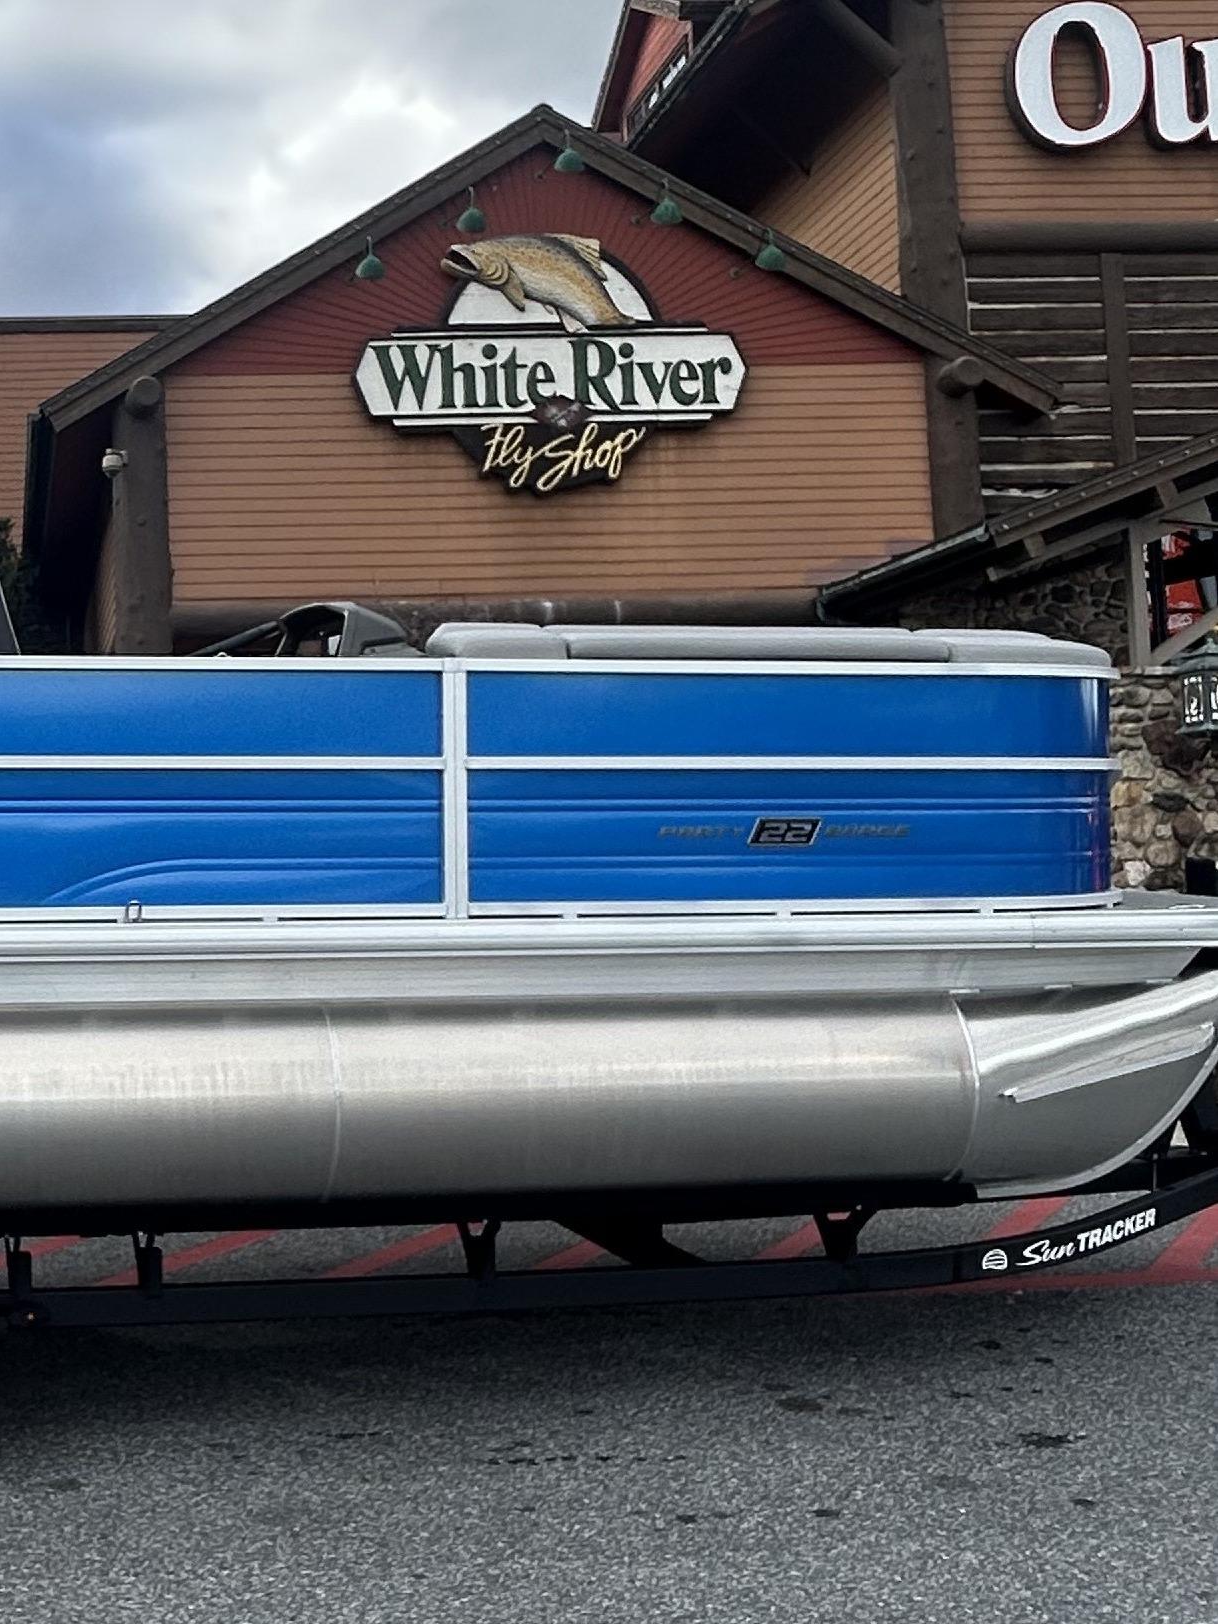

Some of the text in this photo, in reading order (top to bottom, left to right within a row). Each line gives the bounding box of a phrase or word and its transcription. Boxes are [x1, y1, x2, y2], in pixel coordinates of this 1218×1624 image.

[369, 337, 733, 413] White River
[479, 422, 648, 492] Fly Shop
[757, 821, 812, 844] 22
[1015, 1208, 1157, 1267] Sun TRACKER
